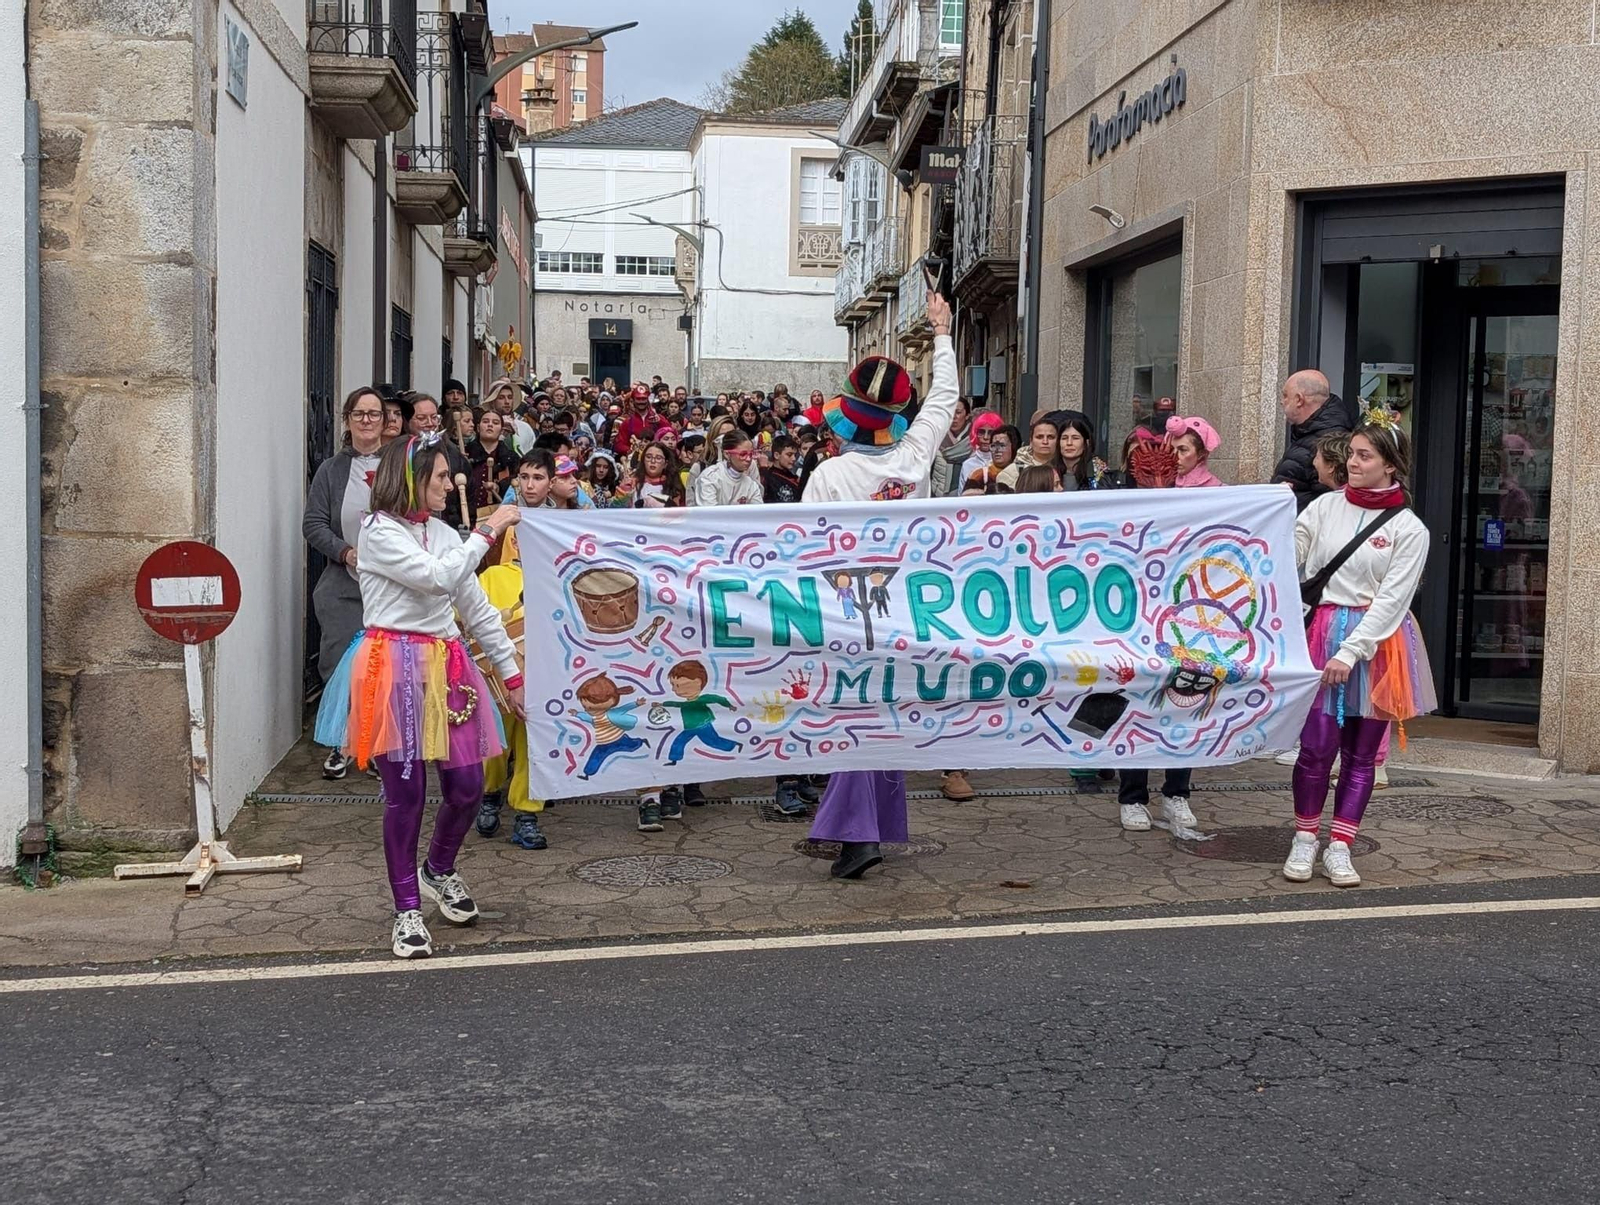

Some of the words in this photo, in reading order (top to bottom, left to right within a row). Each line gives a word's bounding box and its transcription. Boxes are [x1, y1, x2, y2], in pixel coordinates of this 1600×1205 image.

[1088, 54, 1187, 164] Parafarmacia
[565, 300, 647, 314] Notaría
[604, 322, 617, 336] 14
